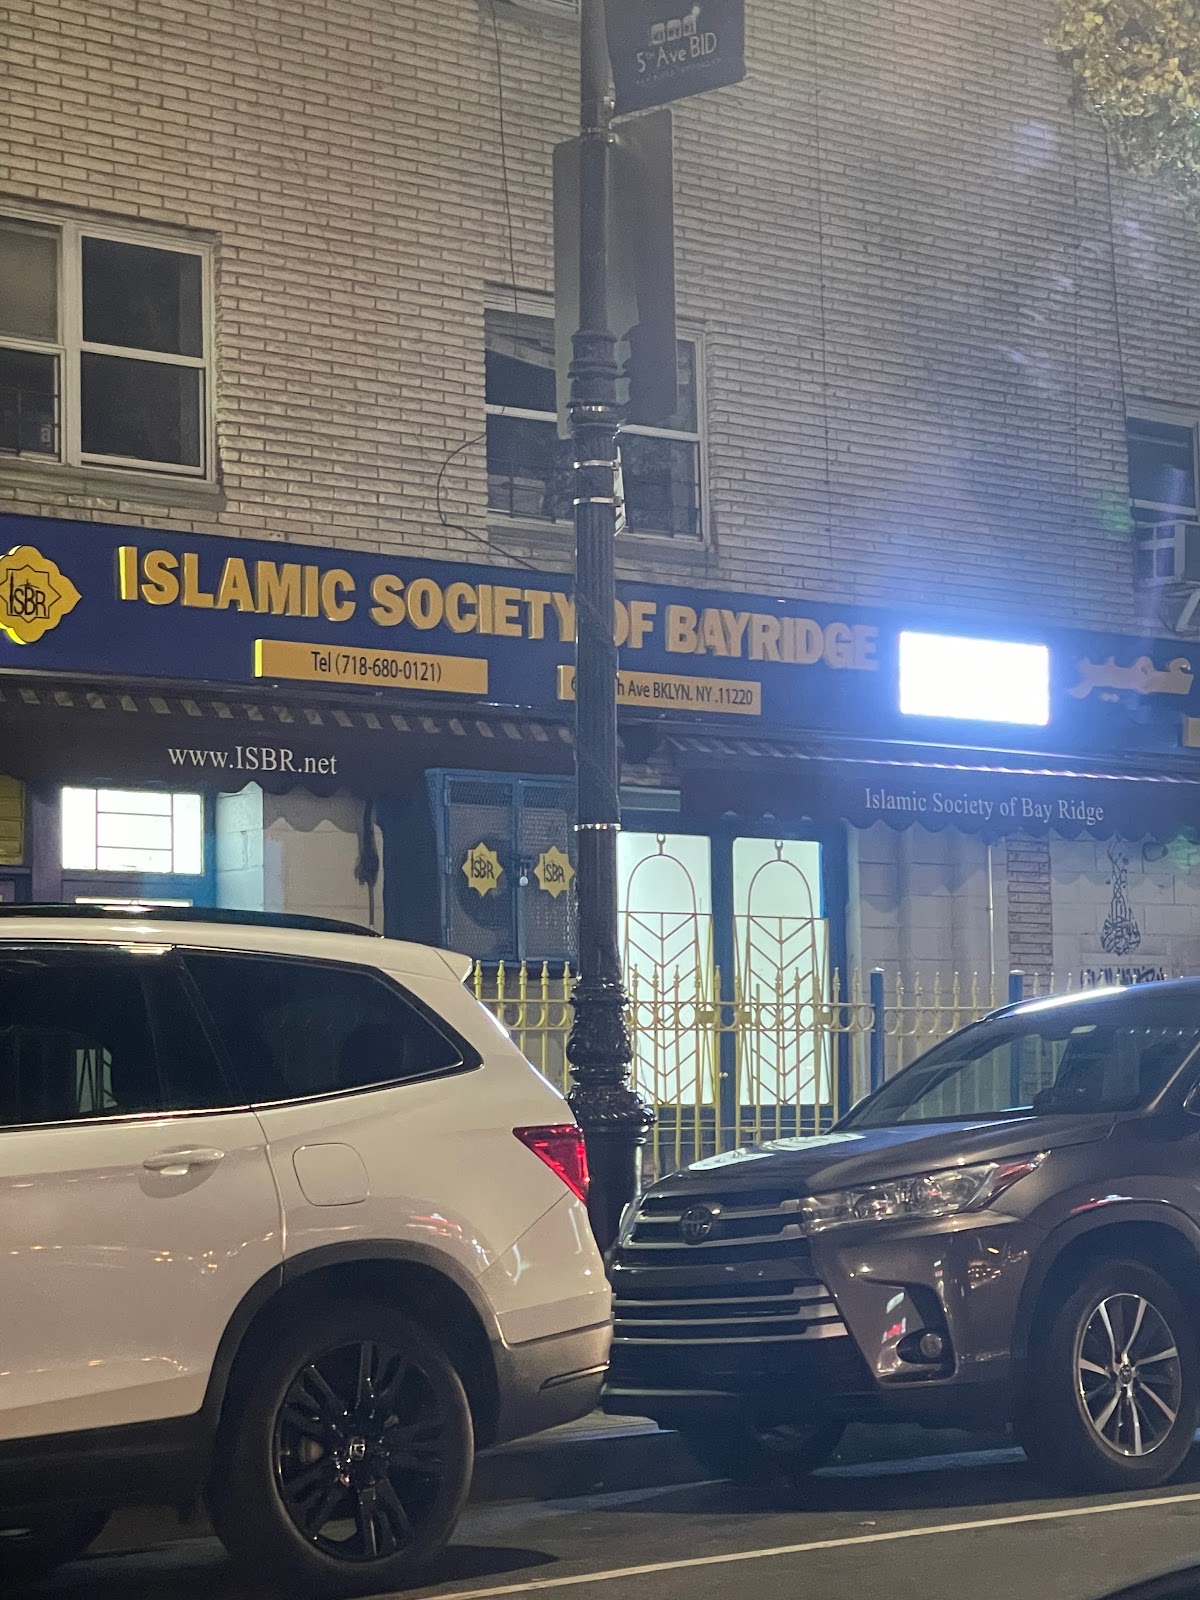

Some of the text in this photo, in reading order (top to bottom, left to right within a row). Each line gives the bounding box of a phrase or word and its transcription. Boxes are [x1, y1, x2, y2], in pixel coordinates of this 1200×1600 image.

[657, 46, 687, 68] Ave
[690, 32, 717, 58] BID
[10, 572, 47, 617] ISBR
[118, 545, 356, 622] ISLAMIC
[370, 573, 576, 642] SOCIETY
[664, 604, 879, 671] BAYRIDGE
[311, 651, 442, 683] Tel (718-680-0121)
[628, 680, 650, 698] Ave
[168, 745, 337, 775] www.ISBR.net
[865, 788, 1104, 825] Islamic Society of Bay Ridge
